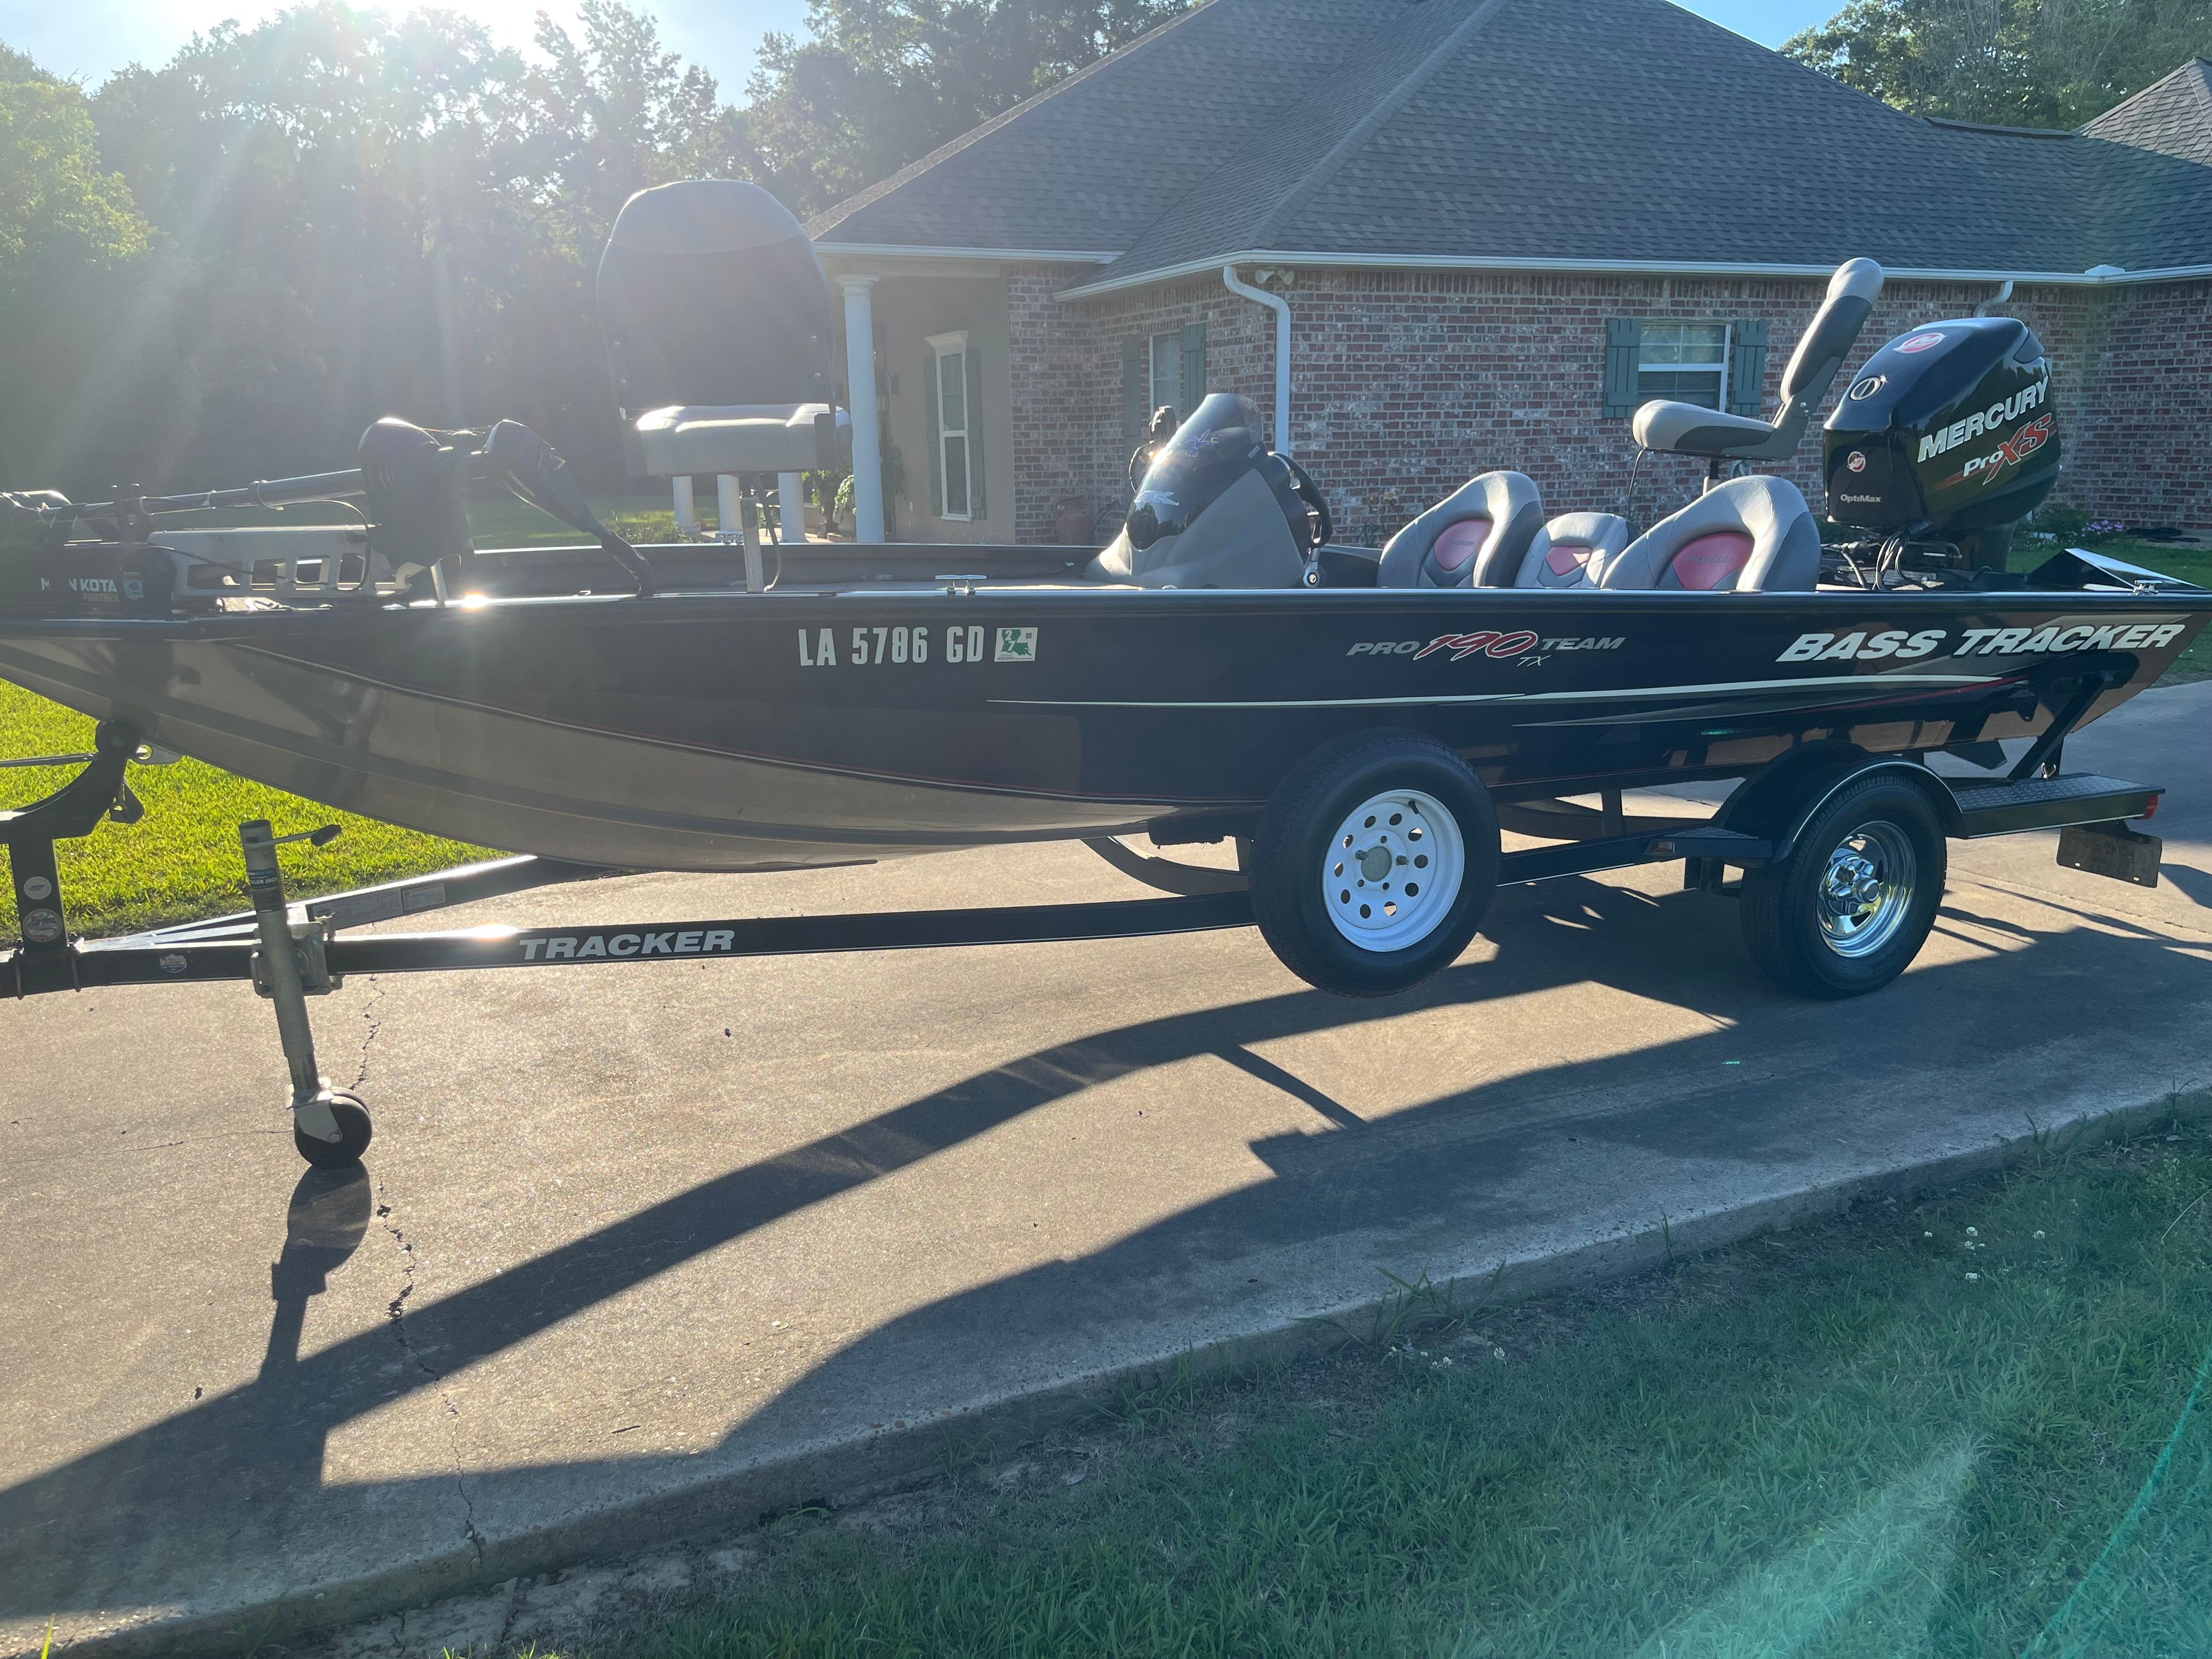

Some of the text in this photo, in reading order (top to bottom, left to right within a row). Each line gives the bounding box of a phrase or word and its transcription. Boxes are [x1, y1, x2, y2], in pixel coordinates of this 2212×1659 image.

[1917, 375, 2049, 463] MERCURY
[1840, 494, 1881, 504] OptiMax
[41, 578, 118, 592] MN KOTA
[798, 625, 985, 667] LA 5786 GD
[1345, 630, 1626, 662] PRO 190 TEAM
[1775, 624, 2186, 662] BASS TRACKER
[1516, 655, 1551, 667] TX
[519, 929, 736, 961] TRACKER
